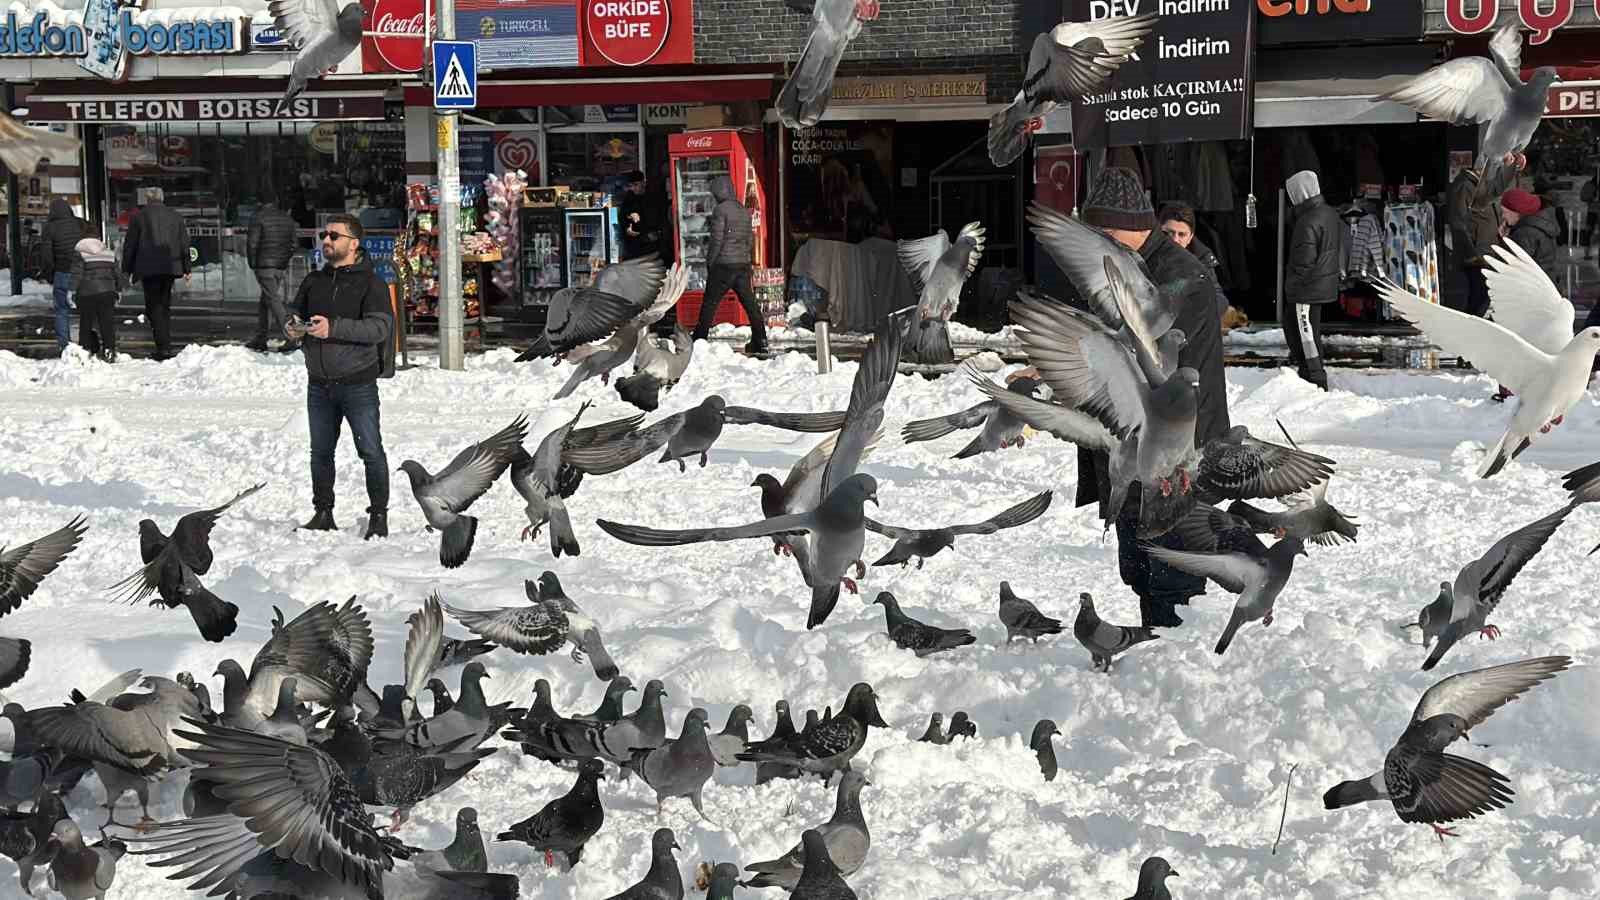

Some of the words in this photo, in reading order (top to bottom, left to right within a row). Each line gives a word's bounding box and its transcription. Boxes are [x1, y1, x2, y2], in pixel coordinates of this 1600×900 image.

[594, 0, 661, 17] ORKİDE
[605, 20, 651, 38] BÜFE
[1159, 35, 1230, 58] İndirim
[1120, 85, 1149, 100] stok
[1153, 78, 1243, 99] KAÇIRMA!!
[66, 101, 184, 119] TELEFON
[199, 98, 319, 118] BORSASI
[1105, 106, 1158, 122] Sadece
[1162, 101, 1181, 117] 10
[1185, 100, 1220, 116] Gün
